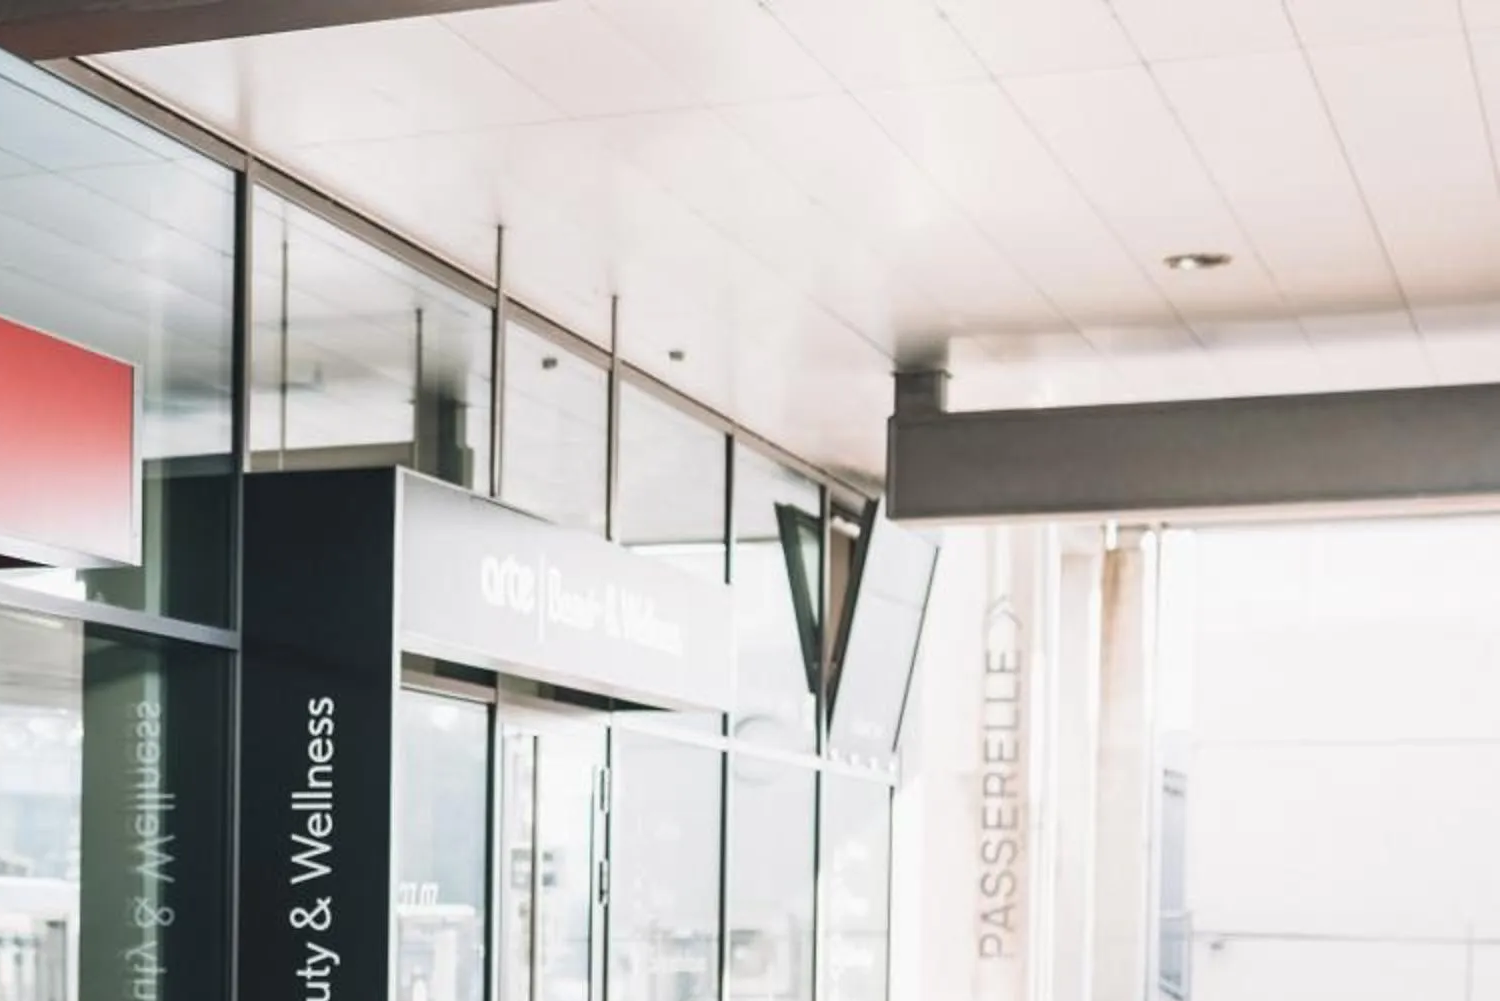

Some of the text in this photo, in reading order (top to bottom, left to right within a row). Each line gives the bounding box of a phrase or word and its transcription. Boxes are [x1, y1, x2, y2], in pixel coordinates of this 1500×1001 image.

[289, 697, 334, 885] Wellness
[979, 649, 1023, 960] PASSERELLE
[289, 896, 332, 931] &
